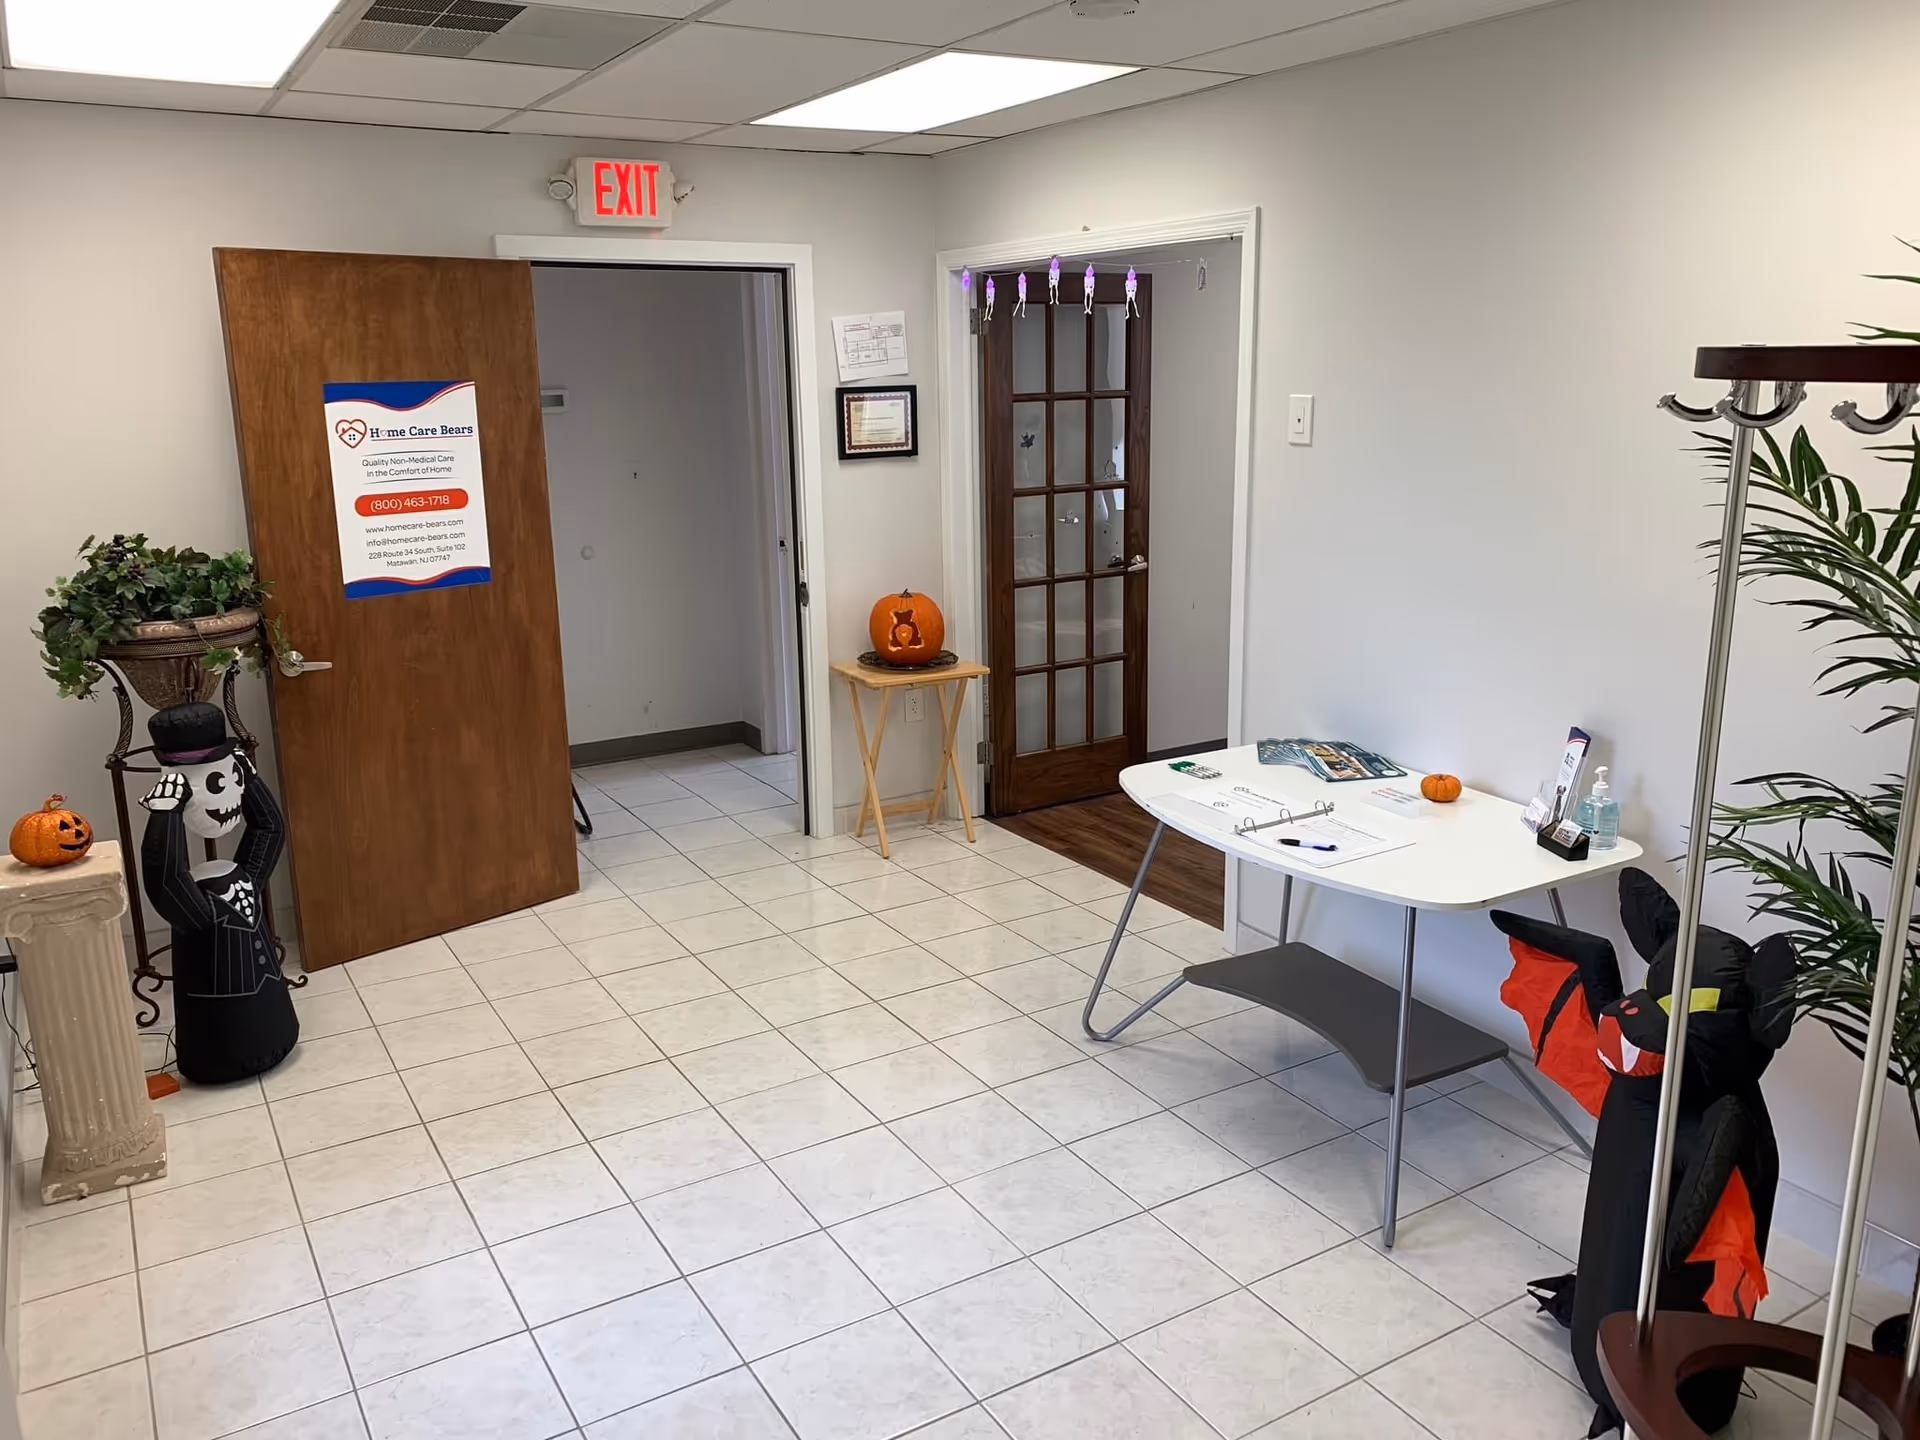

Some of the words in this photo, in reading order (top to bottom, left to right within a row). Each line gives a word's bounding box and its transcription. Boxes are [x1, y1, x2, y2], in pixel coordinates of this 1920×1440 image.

[593, 161, 659, 217] EXIT
[409, 426, 437, 436] Care
[440, 425, 473, 435] Bears
[362, 458, 389, 467] Quality
[390, 455, 436, 465] Non-Medical
[388, 467, 421, 476] Comfort
[370, 498, 403, 513] (800)
[404, 495, 450, 507] 463-1718
[365, 519, 464, 534] www.homecare-bears.com
[366, 532, 466, 547] info@homecare-bears.com
[368, 552, 382, 560] 228
[383, 549, 404, 558] Route
[404, 548, 413, 556] 34
[436, 545, 453, 553] Suite
[454, 543, 466, 551] 102
[386, 558, 419, 567] Matawan,
[419, 557, 429, 565] NJ
[430, 554, 451, 563] 07747
